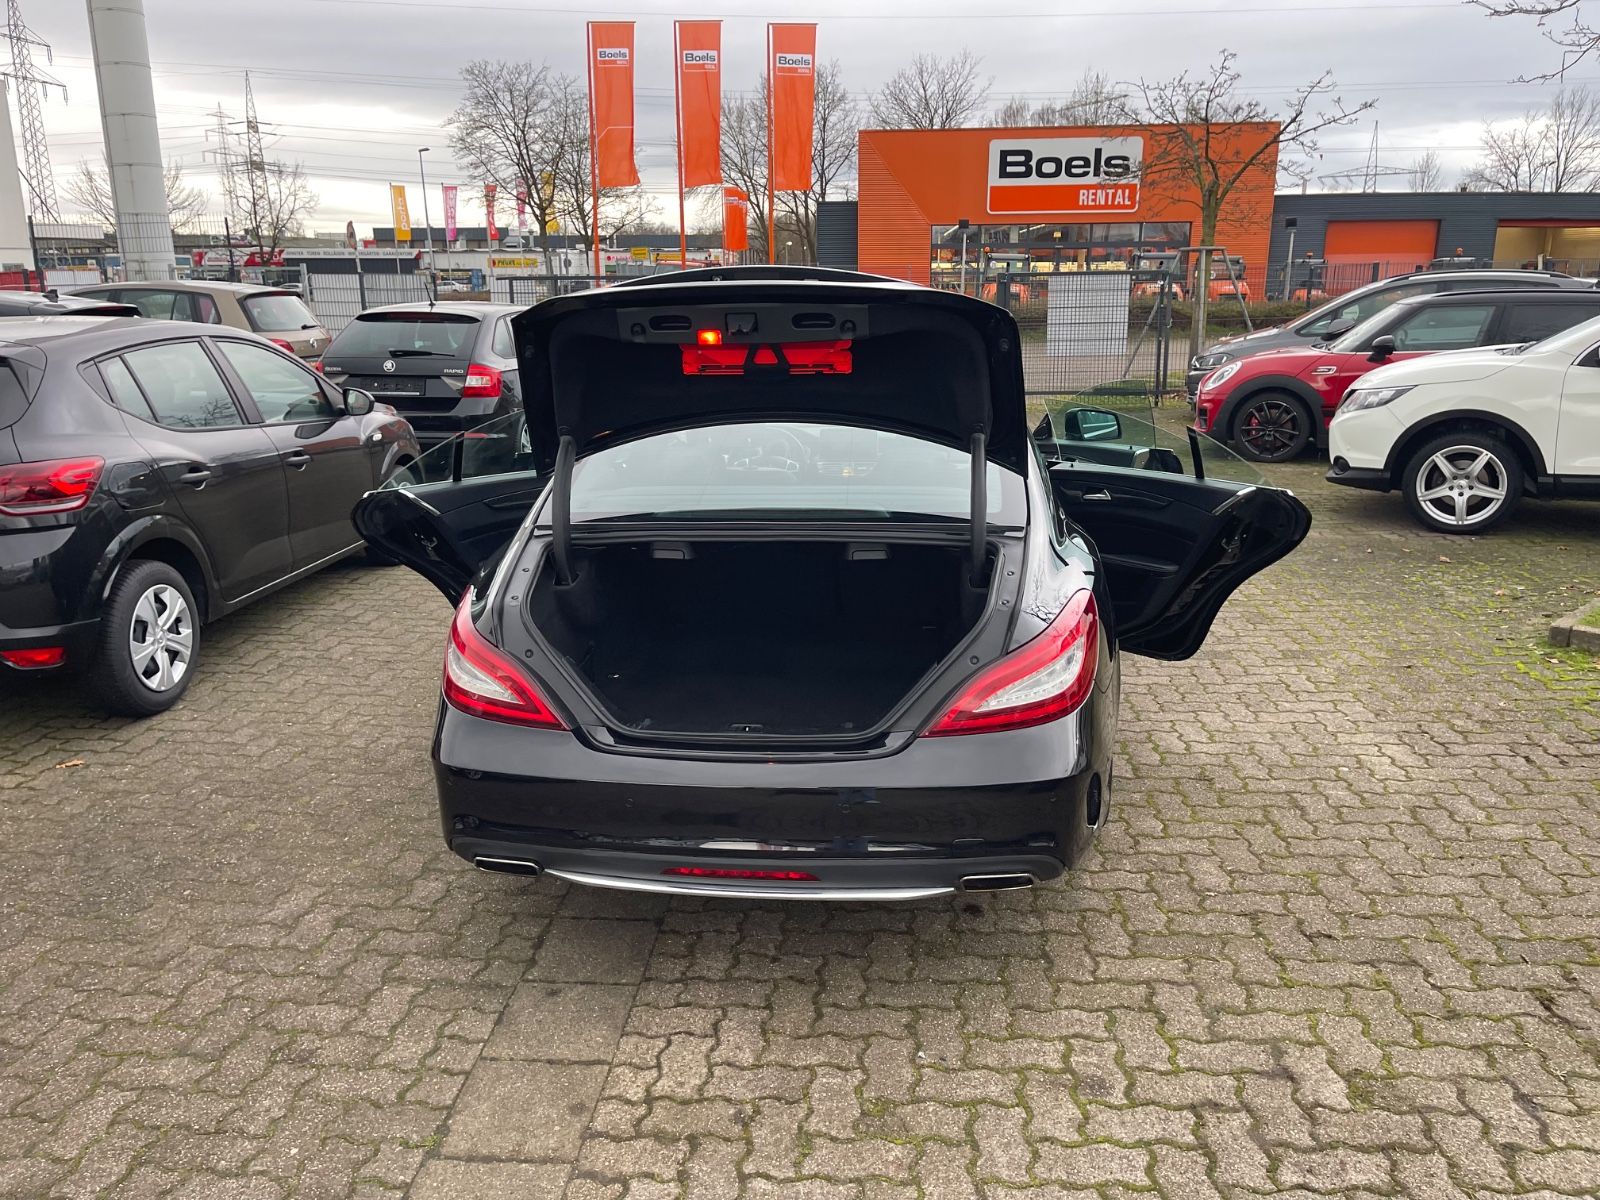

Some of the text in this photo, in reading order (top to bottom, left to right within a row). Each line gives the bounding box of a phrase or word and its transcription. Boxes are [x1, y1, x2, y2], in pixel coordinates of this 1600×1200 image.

[598, 50, 628, 59] Boels
[684, 52, 716, 62] Boels
[778, 55, 811, 66] Boels
[999, 147, 1131, 179] Boels
[1079, 188, 1132, 206] RENTAL
